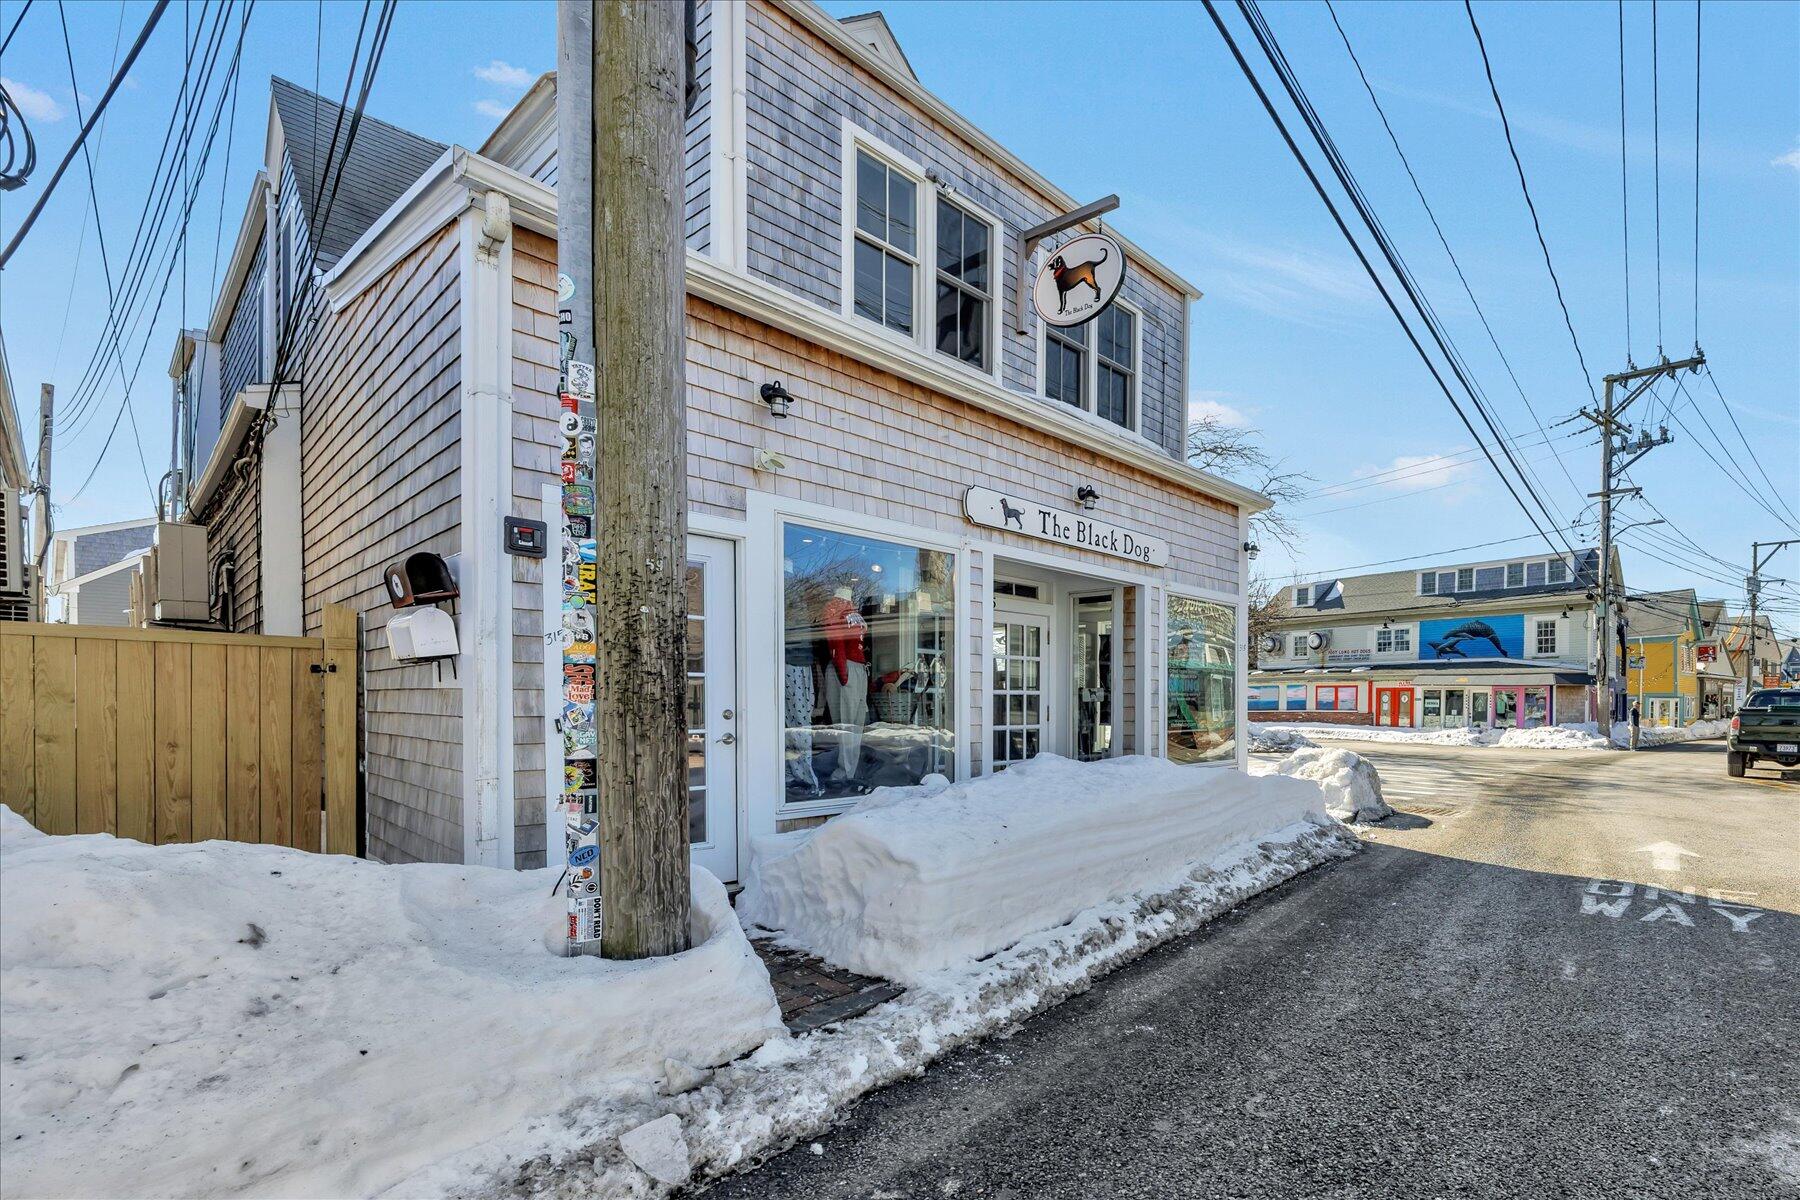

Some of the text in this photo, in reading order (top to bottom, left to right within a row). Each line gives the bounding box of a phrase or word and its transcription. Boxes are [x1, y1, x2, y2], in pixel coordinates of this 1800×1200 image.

[1073, 305, 1084, 313] Black
[1038, 509, 1150, 562] The Black Dog
[1579, 895, 1766, 933] WAY
[593, 919, 601, 939] READ
